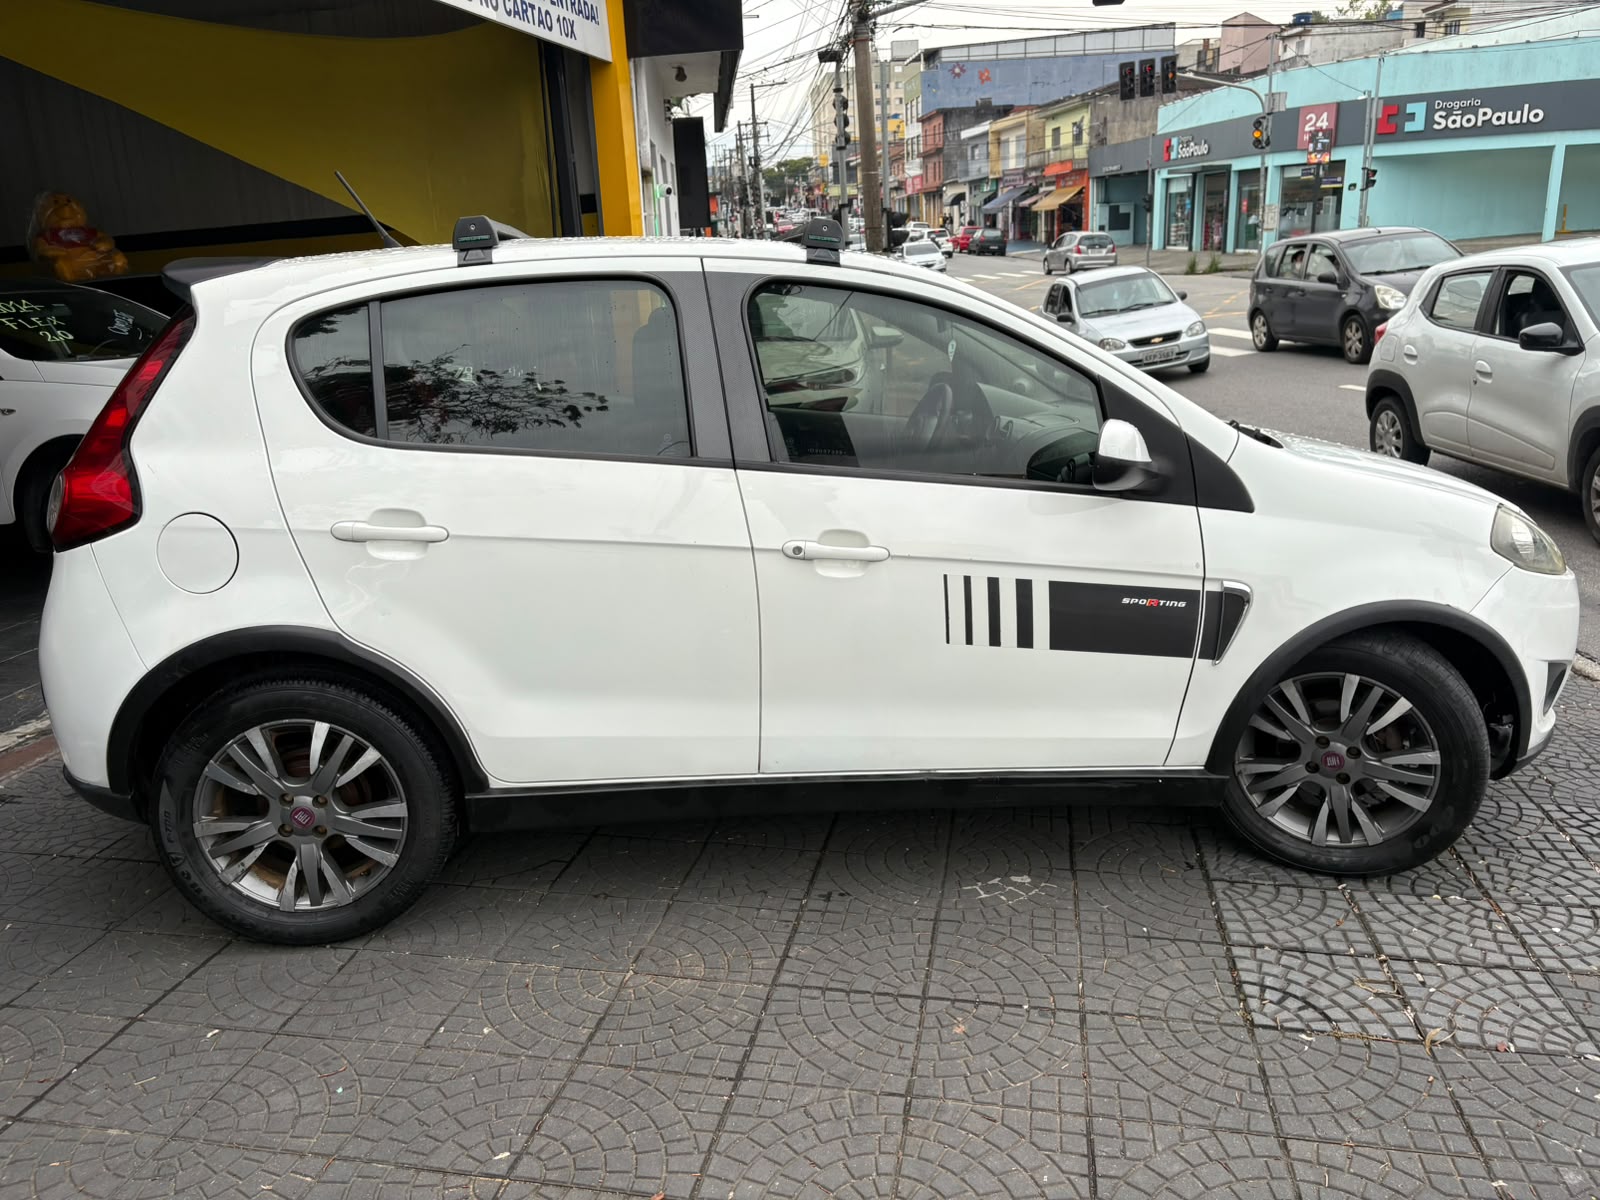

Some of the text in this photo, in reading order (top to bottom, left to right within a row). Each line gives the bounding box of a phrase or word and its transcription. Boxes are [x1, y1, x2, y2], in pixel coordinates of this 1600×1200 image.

[503, 0, 553, 32] CARTAO
[555, 14, 577, 41] 10X
[1434, 98, 1481, 110] Drogaria
[1304, 112, 1328, 132] 24
[1433, 103, 1544, 130] SãoPaulo
[0, 316, 66, 330] FLEX
[1121, 597, 1187, 608] SPORTING
